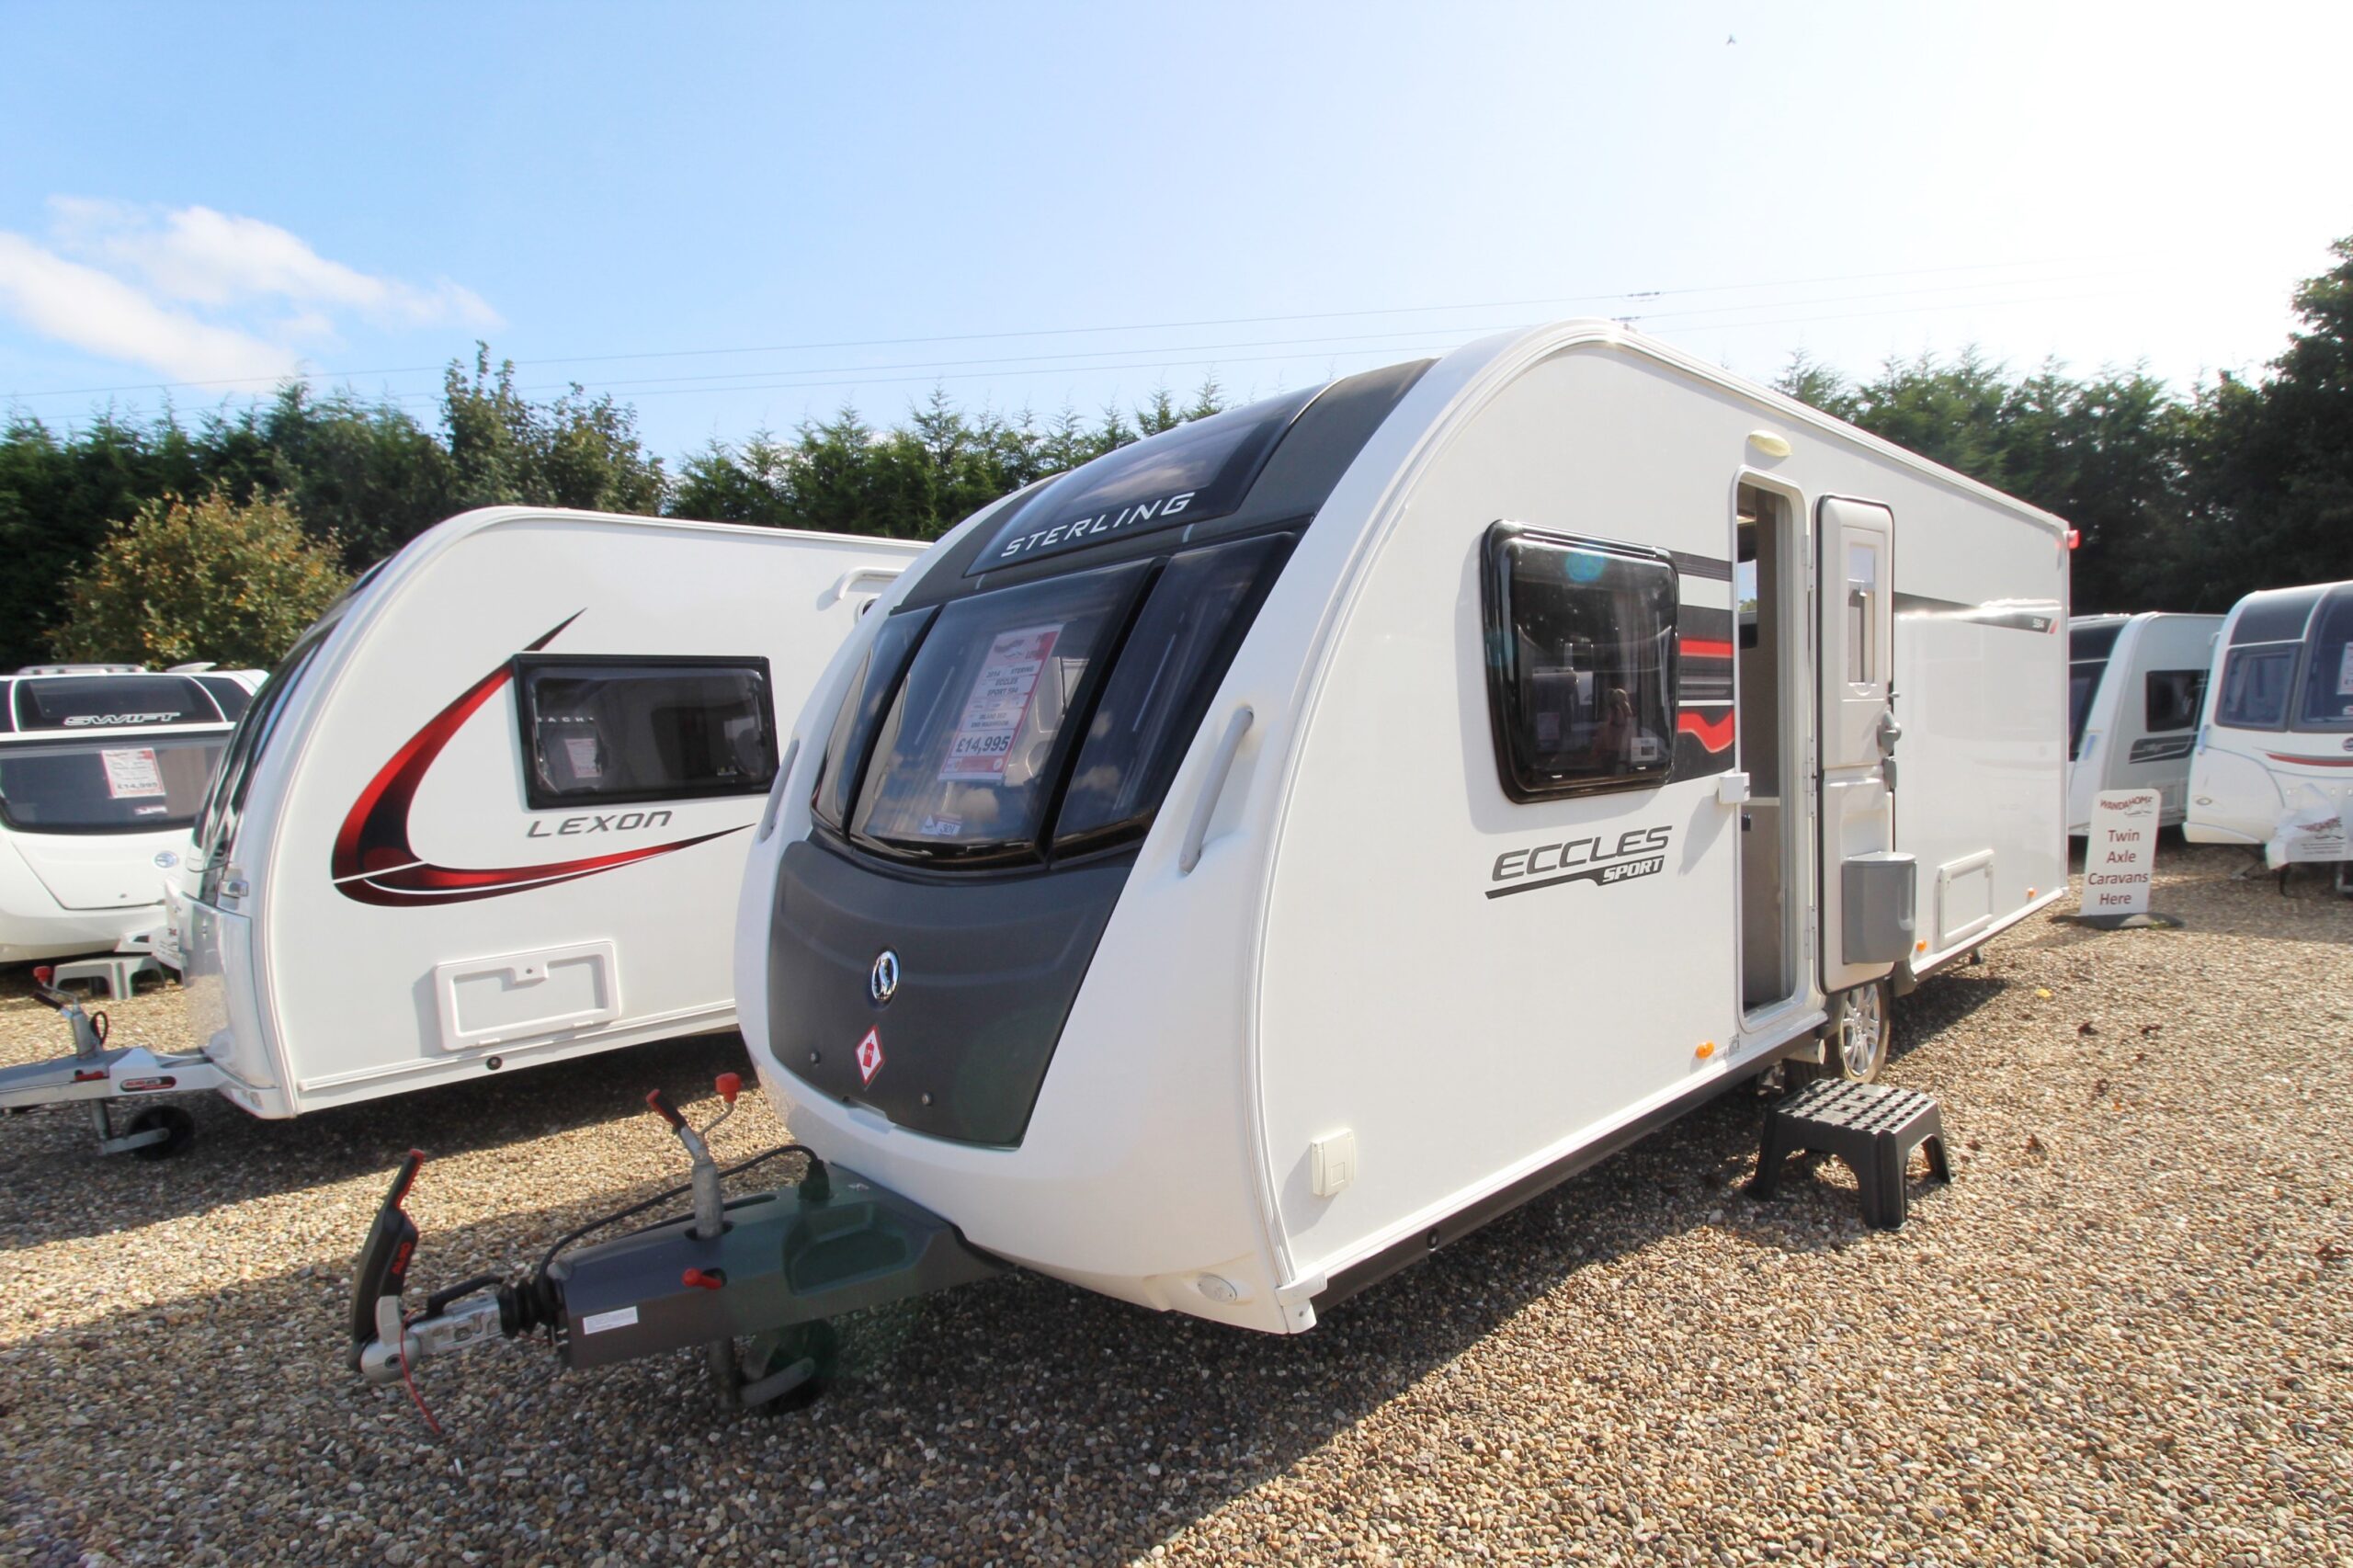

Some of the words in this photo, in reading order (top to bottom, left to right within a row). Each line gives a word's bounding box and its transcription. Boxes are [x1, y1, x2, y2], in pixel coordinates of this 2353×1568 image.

[1001, 492, 1195, 557] STERLING
[63, 712, 181, 726] SWIFT
[956, 736, 1011, 755] £14,995
[527, 811, 673, 837] LEXON
[2108, 828, 2140, 842] Twin
[1492, 825, 1673, 881] ECCLES
[2106, 850, 2136, 863] Axle
[1603, 858, 1664, 882] SPORT
[2088, 872, 2148, 885] Caravans
[2098, 893, 2131, 905] Here
